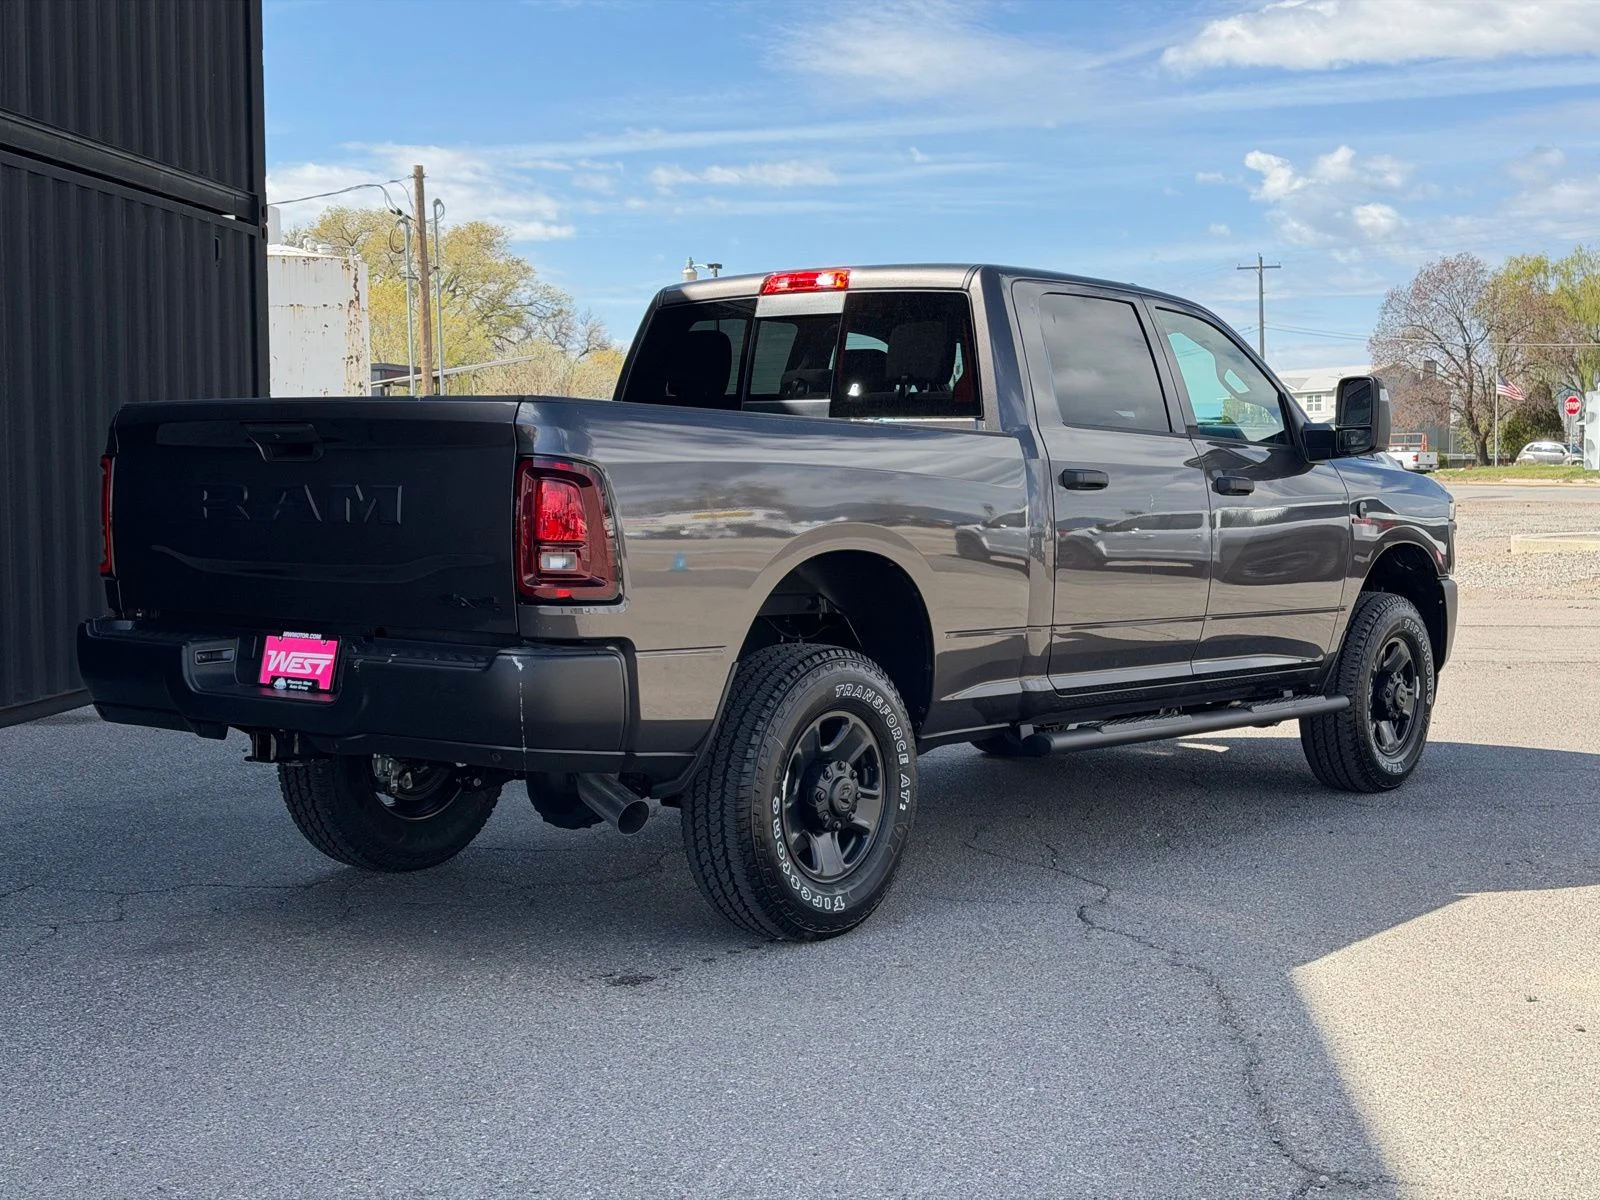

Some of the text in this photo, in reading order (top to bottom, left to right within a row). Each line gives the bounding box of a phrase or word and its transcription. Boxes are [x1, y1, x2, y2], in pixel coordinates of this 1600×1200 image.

[1566, 402, 1579, 410] STOP
[195, 483, 402, 525] RAM
[267, 650, 334, 675] WEST
[836, 684, 909, 765] TRANSFORCE
